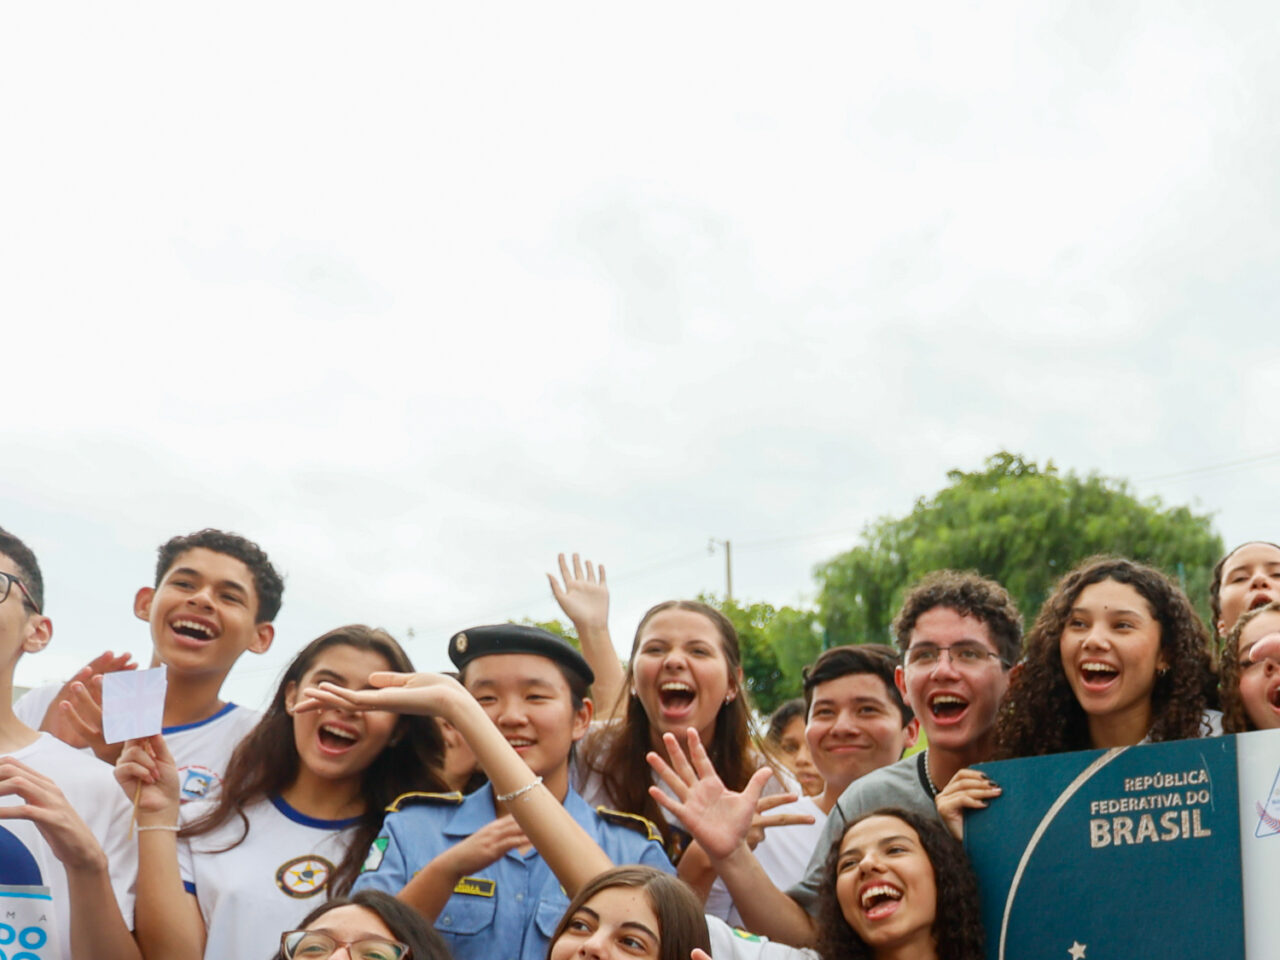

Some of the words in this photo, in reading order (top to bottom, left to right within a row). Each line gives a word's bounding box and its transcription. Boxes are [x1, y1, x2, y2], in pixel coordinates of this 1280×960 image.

[1124, 769, 1209, 791] REPÚBLICA
[1090, 793, 1182, 815] FEDERATIVA
[1186, 790, 1210, 805] DO
[1090, 808, 1212, 848] BRASIL
